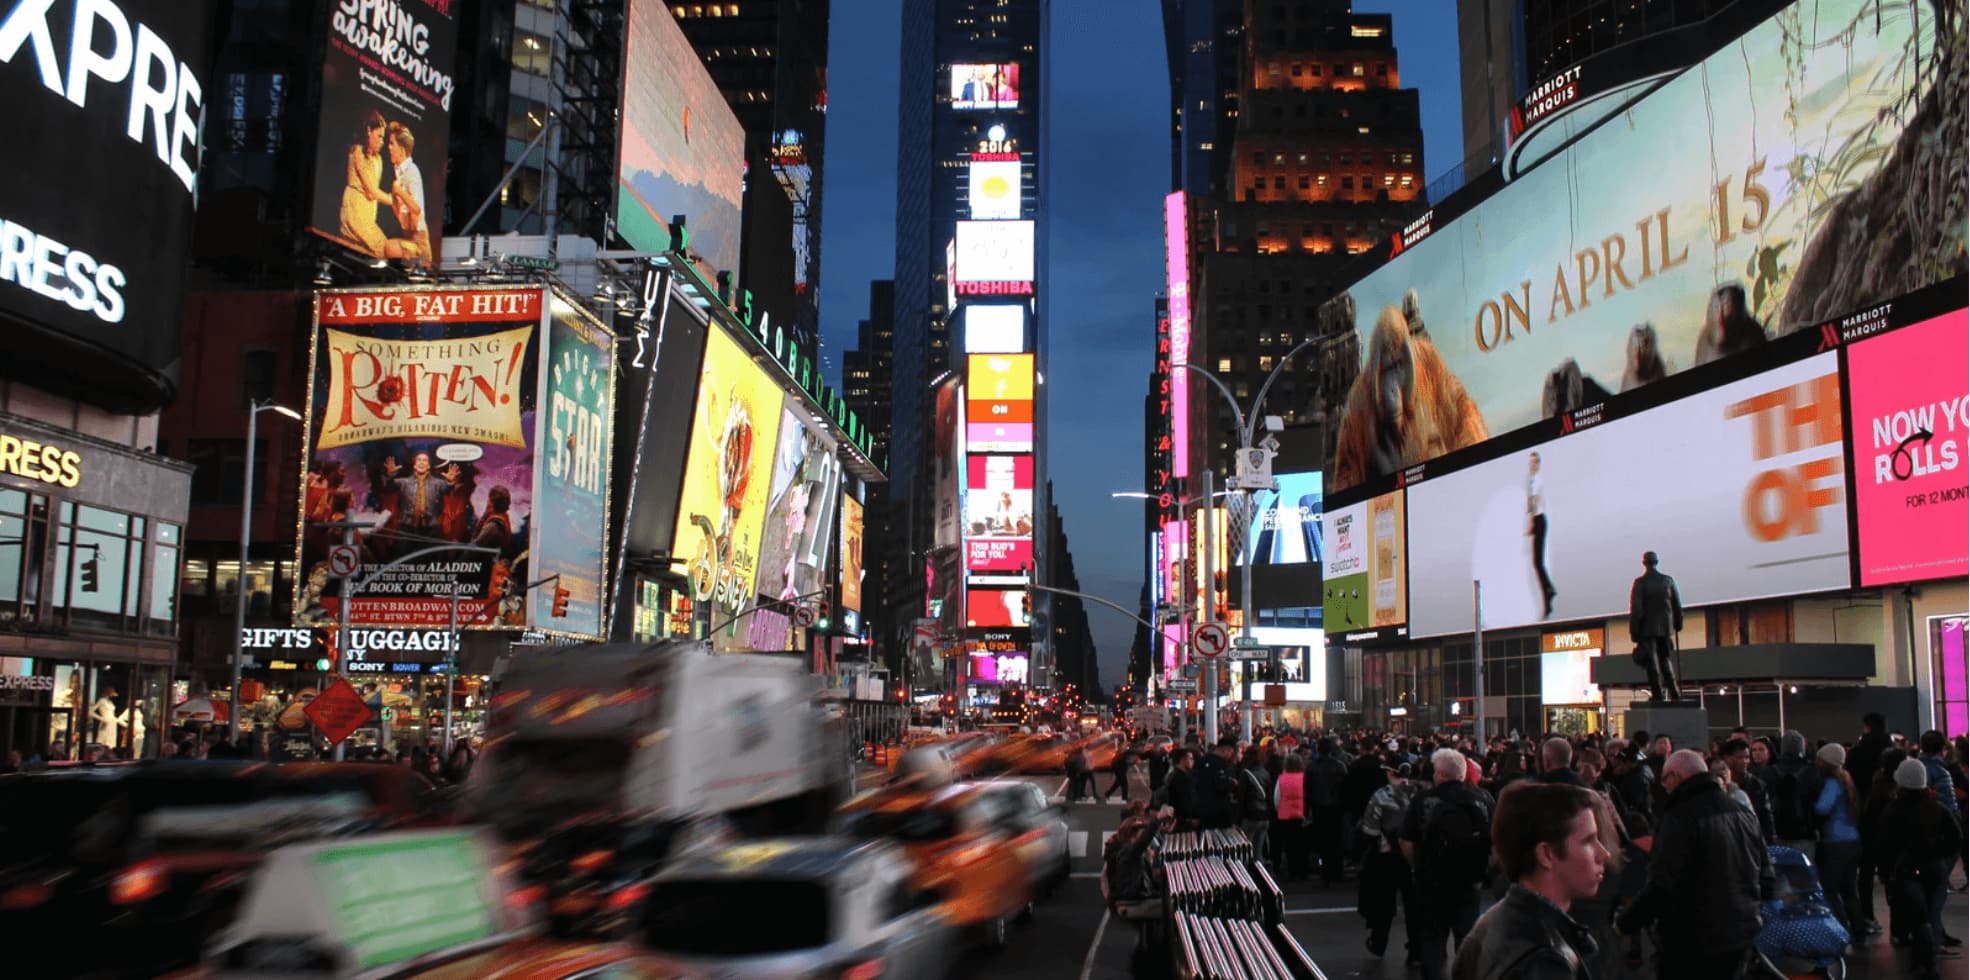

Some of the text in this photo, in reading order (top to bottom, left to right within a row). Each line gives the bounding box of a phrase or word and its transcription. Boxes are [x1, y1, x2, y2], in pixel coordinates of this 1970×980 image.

[333, 11, 454, 112] awakening
[1525, 65, 1581, 108] MARRIOTT
[0, 0, 206, 205] XPRE
[1526, 86, 1574, 122] MARQUIS
[972, 153, 1020, 161] TOSHIBA
[979, 140, 1012, 153] 2016
[1475, 155, 1770, 353] ON APRIL 15
[957, 281, 1033, 294] TOSHIBA
[414, 296, 463, 316] FAT
[1843, 304, 1892, 329] MARRIOTT
[1843, 319, 1887, 340] MARQUIS
[356, 339, 501, 360] SOMETHING
[1158, 317, 1171, 416] ERNST
[451, 426, 471, 436] NEW
[1872, 404, 1936, 448] NOW
[550, 390, 602, 496] STAR
[1159, 436, 1171, 449] &
[0, 435, 82, 489] RESS
[1741, 455, 1844, 543] OF
[1906, 493, 1926, 509] FOR
[1929, 491, 1939, 505] 12
[971, 542, 989, 551] THIS
[427, 562, 482, 573] ALADDIN
[369, 583, 402, 594] BOOK
[410, 583, 424, 594] OF
[241, 628, 461, 651] GIFTS UGGAGE
[984, 633, 1012, 641] SONY
[1554, 632, 1590, 649] INVICTA
[349, 662, 385, 672] SONY
